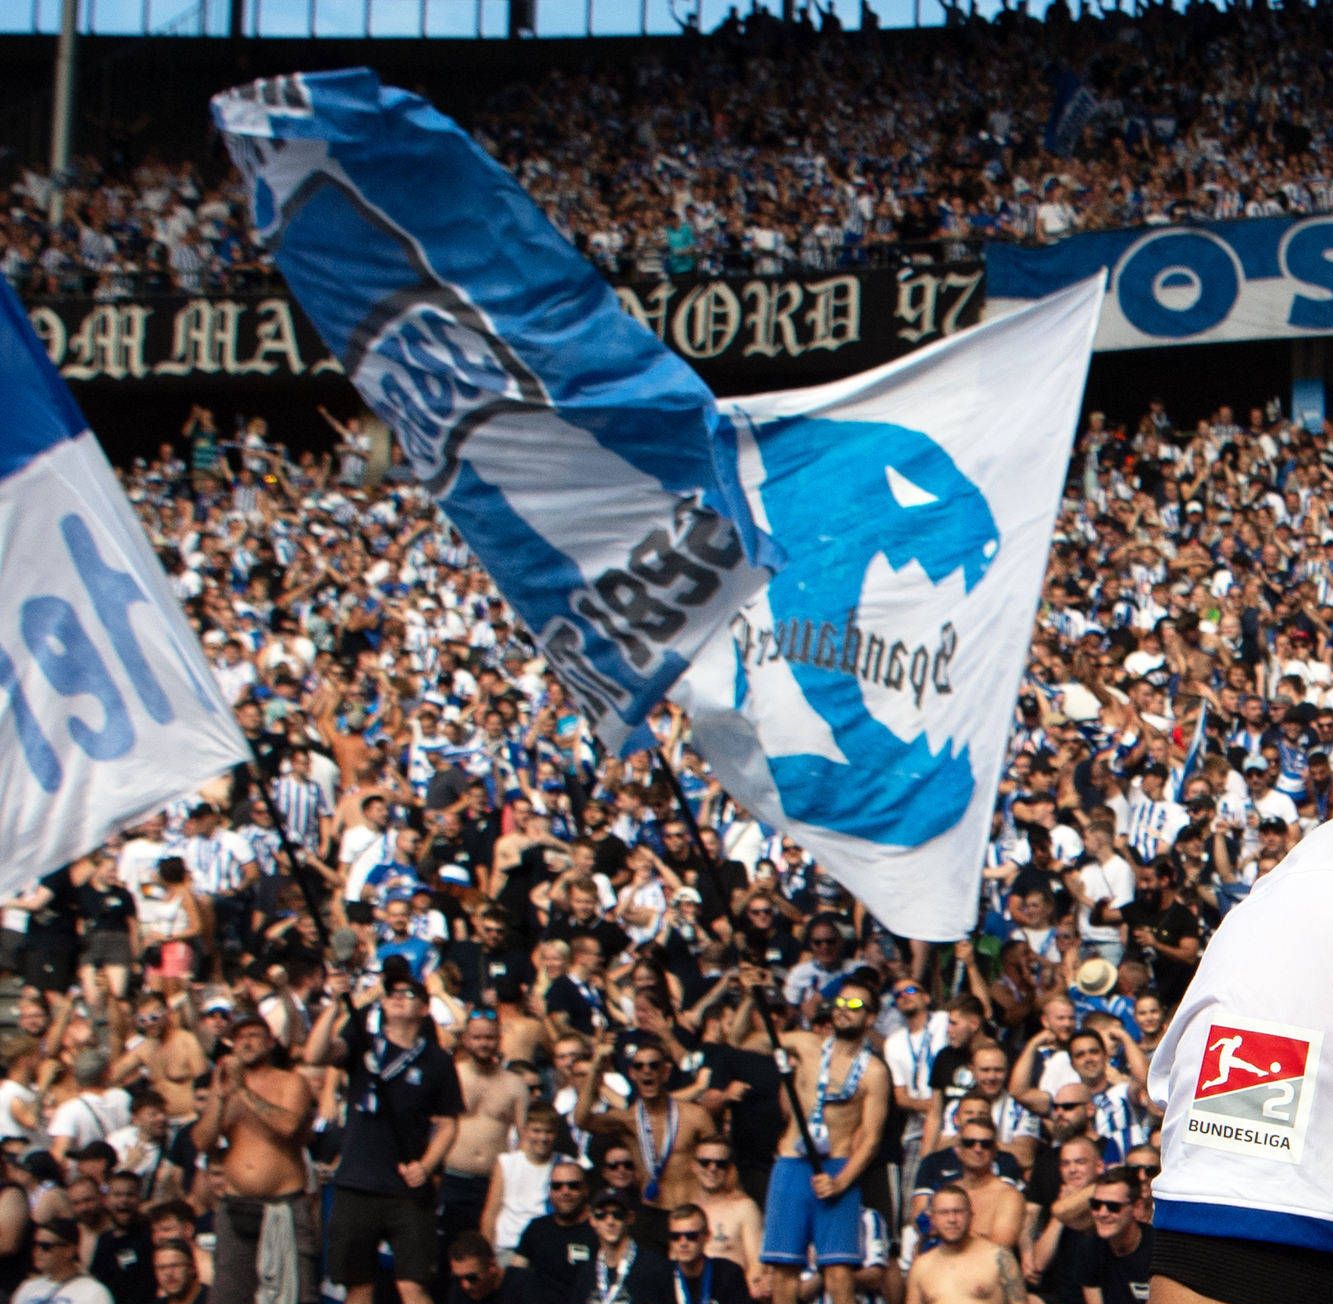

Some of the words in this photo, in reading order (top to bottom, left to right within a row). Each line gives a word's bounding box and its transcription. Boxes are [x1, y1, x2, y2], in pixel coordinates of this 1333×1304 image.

[28, 298, 345, 380] OMMA
[615, 273, 861, 359] NORD
[1262, 1082, 1294, 1121] 2
[1187, 1118, 1292, 1150] BUNDESLIGA
